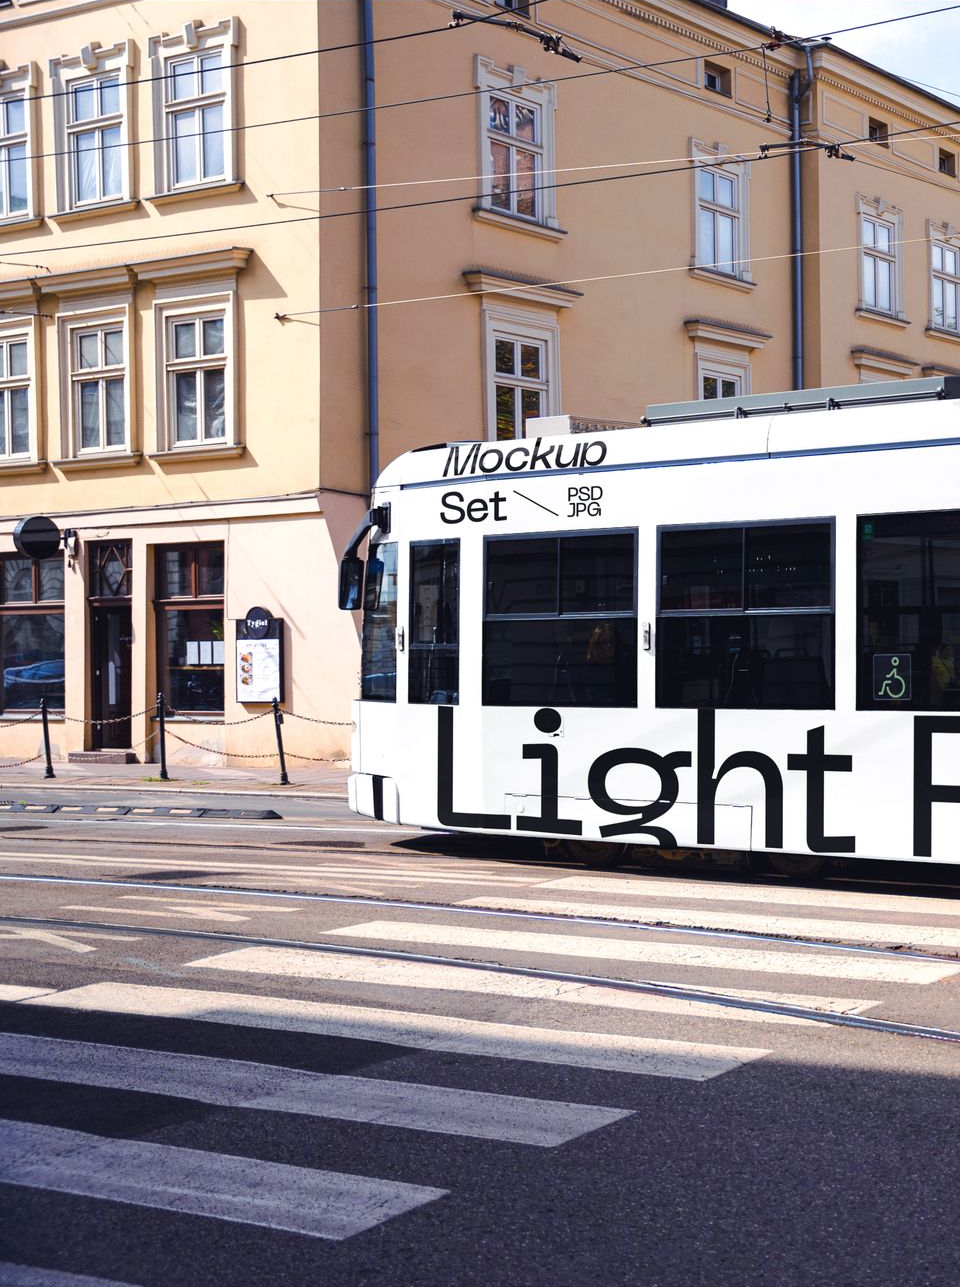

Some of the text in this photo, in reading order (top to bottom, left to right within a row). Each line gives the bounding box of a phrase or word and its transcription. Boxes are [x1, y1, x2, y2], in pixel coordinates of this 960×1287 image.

[442, 436, 607, 477] Mockup
[440, 491, 507, 524] Set
[567, 485, 603, 502] PSD
[567, 502, 602, 518] JPG
[437, 706, 856, 854] Light
